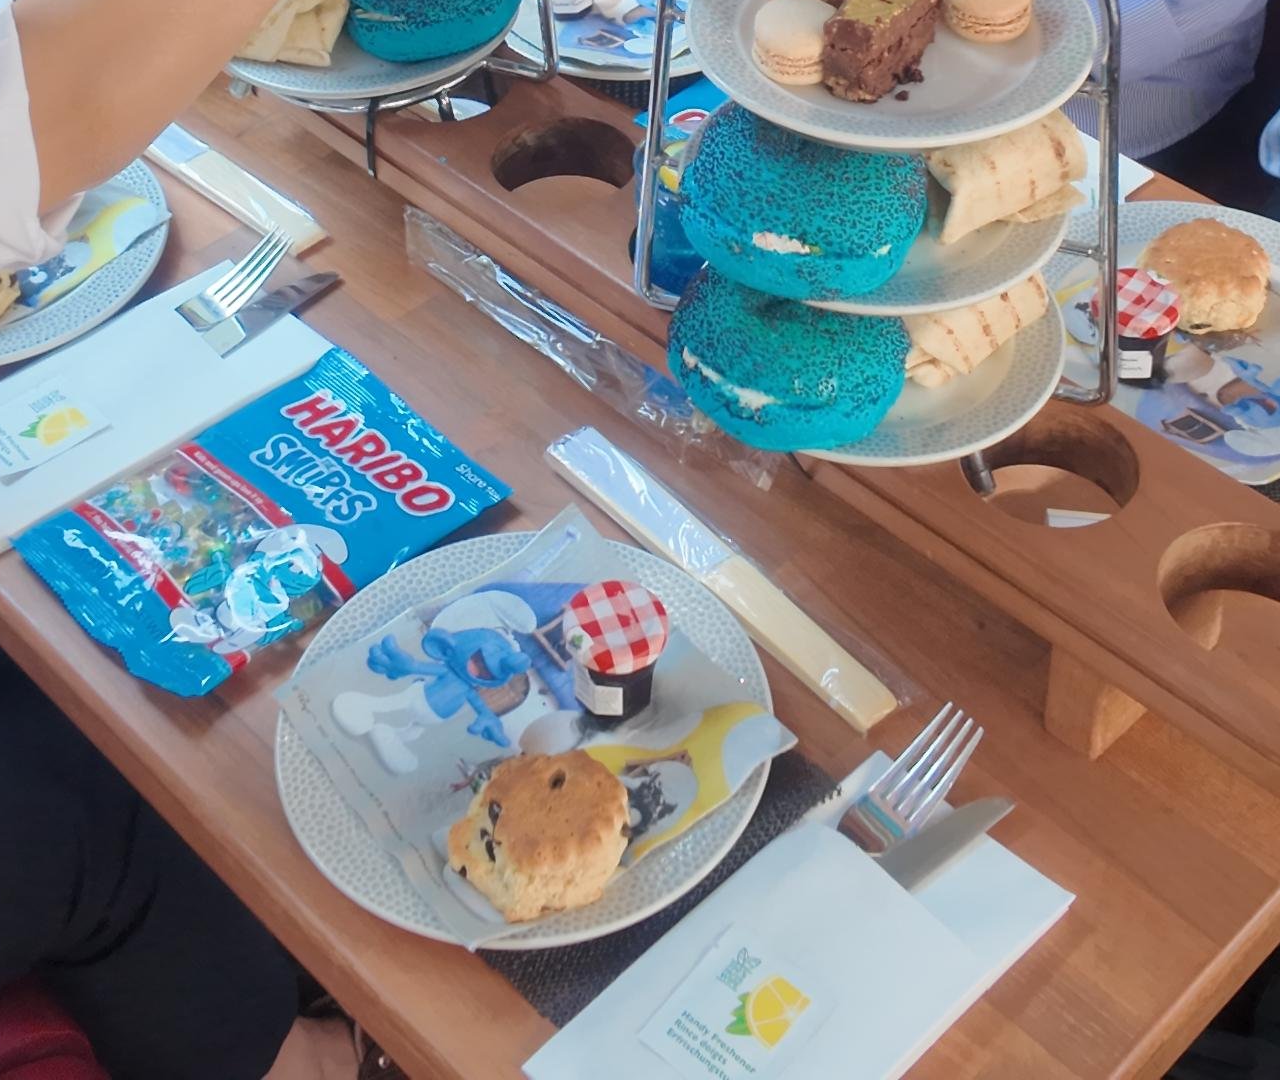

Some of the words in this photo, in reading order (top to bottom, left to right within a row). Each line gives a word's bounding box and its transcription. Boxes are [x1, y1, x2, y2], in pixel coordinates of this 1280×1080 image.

[249, 433, 377, 524] SMURFS
[282, 391, 453, 515] HARIBO
[455, 463, 487, 488] Share
